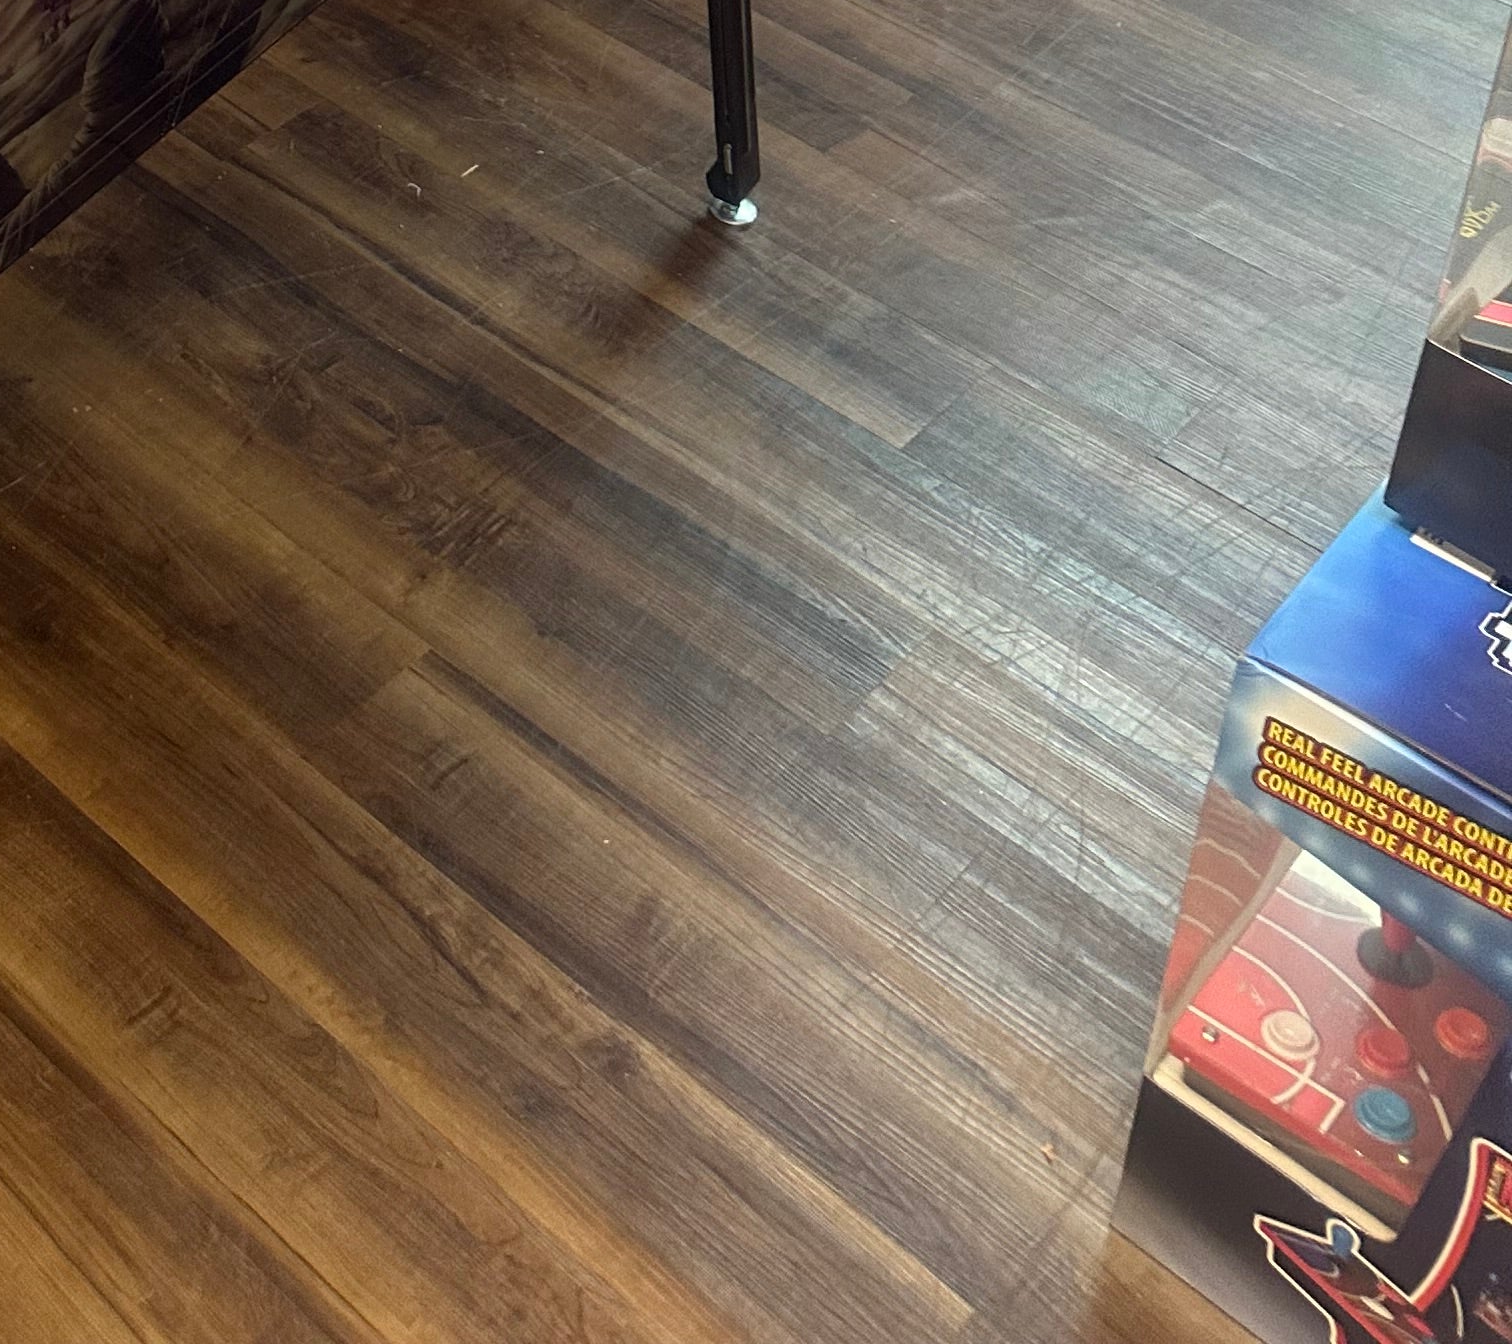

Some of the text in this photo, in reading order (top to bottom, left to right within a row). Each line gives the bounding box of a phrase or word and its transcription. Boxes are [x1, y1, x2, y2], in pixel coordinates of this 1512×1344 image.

[1262, 744, 1388, 824] COMMANDES
[1391, 812, 1420, 839] DE
[1268, 719, 1316, 760] REAL
[1319, 742, 1365, 786] FEEL
[1368, 771, 1450, 828] ARCADE
[1257, 768, 1368, 838] CONTROLES
[1371, 825, 1399, 853] DE
[1399, 844, 1485, 899] ARCADA
